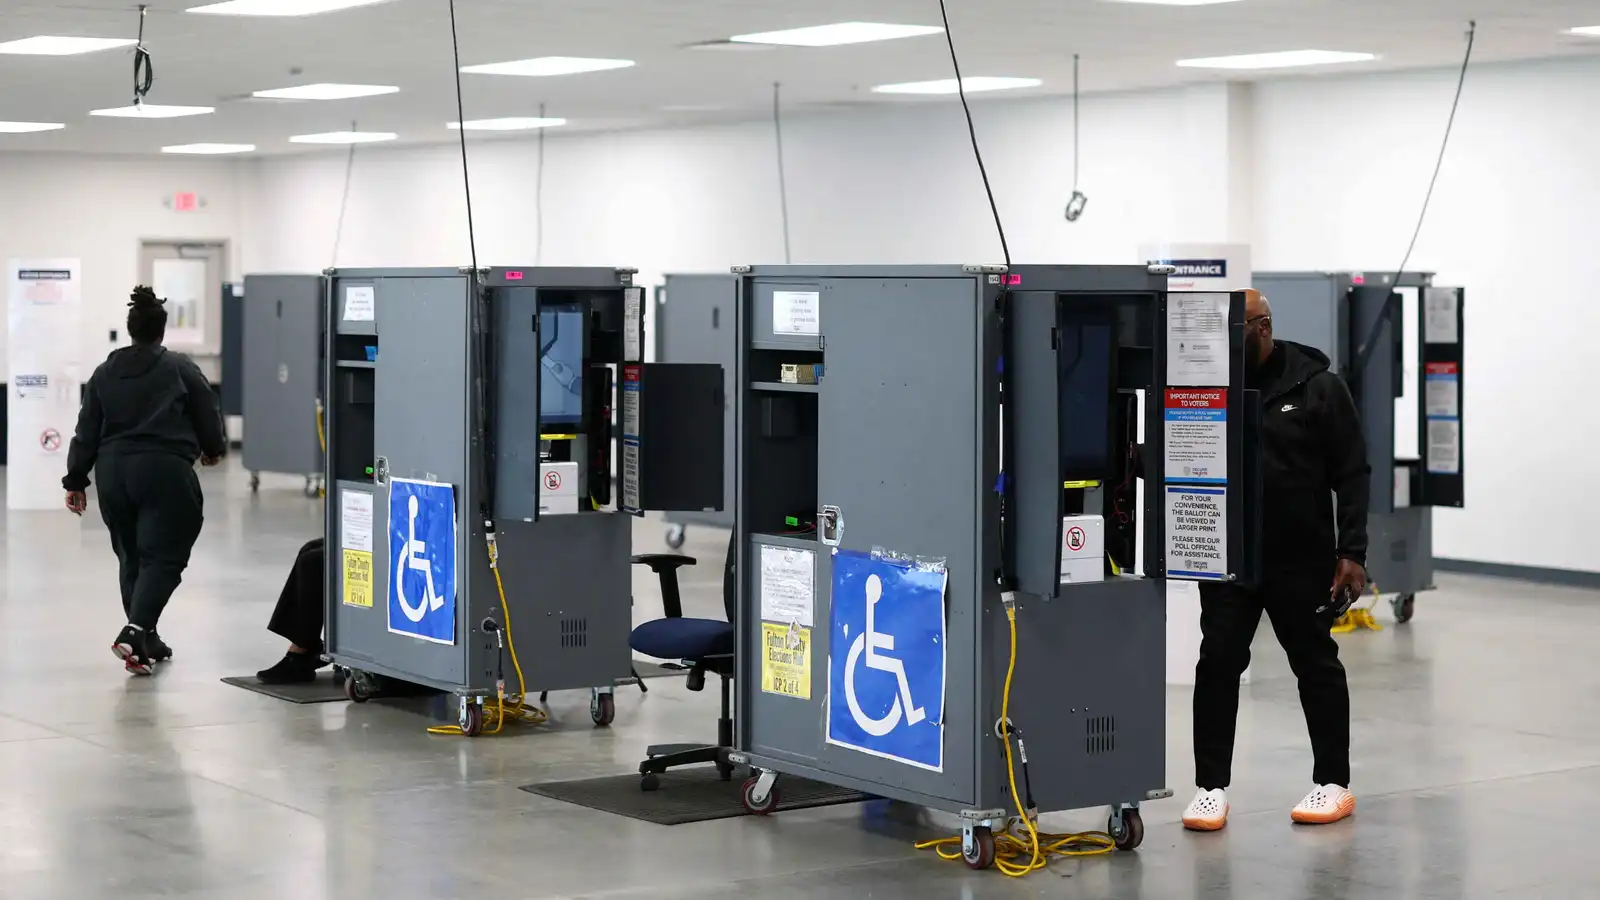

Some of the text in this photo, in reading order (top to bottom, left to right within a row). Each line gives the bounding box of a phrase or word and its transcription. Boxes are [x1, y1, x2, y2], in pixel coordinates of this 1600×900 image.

[1174, 264, 1221, 275] NTRANCE
[1191, 544, 1217, 552] OFFICIAL
[767, 631, 784, 648] Fulton
[769, 647, 792, 664] Elections
[773, 677, 799, 694] ICP 2 of 4
